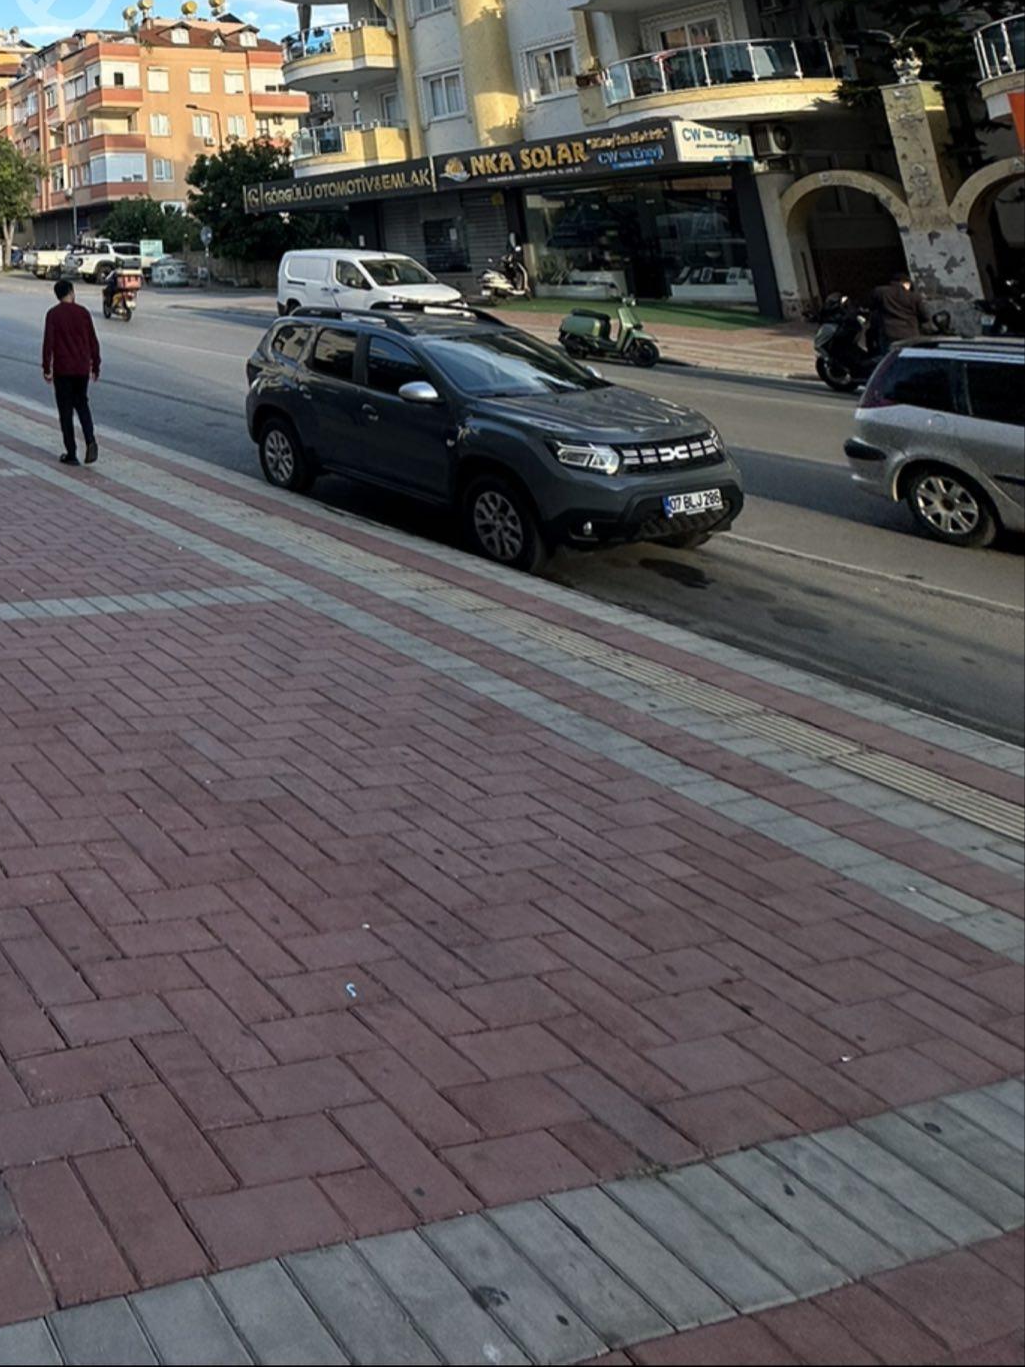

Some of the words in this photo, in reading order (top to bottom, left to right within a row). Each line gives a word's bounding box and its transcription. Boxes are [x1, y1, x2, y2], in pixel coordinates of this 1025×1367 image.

[470, 150, 516, 176] NKA
[519, 140, 590, 171] SOLAR
[670, 496, 681, 511] 07
